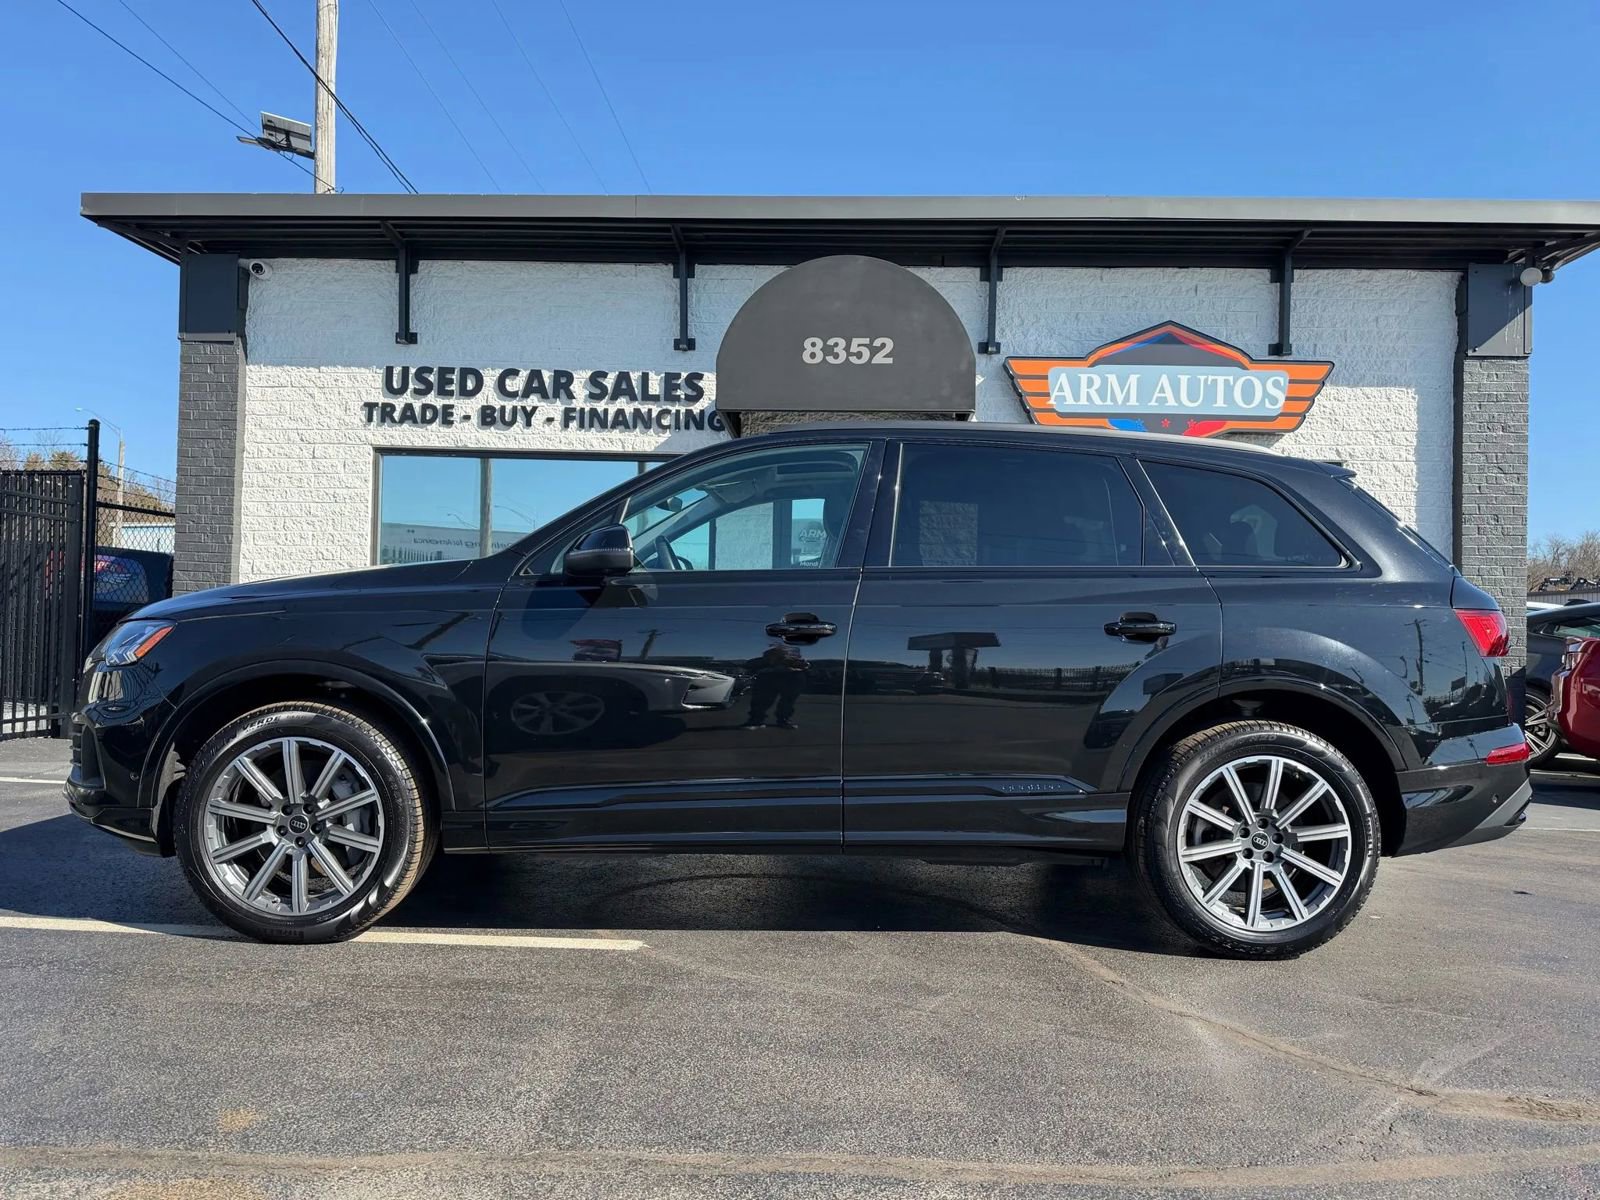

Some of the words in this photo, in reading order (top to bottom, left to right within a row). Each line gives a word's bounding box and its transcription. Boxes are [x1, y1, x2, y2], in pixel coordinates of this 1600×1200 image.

[802, 337, 894, 364] 8352
[385, 366, 484, 397] USED
[497, 368, 575, 399] CAR
[588, 370, 705, 403] SALES
[1046, 373, 1141, 406] ARM
[1148, 375, 1287, 409] AUTOS
[363, 402, 455, 426] TRADE
[480, 405, 539, 427] BUY
[563, 407, 726, 432] FINANCING
[799, 529, 827, 538] ARM
